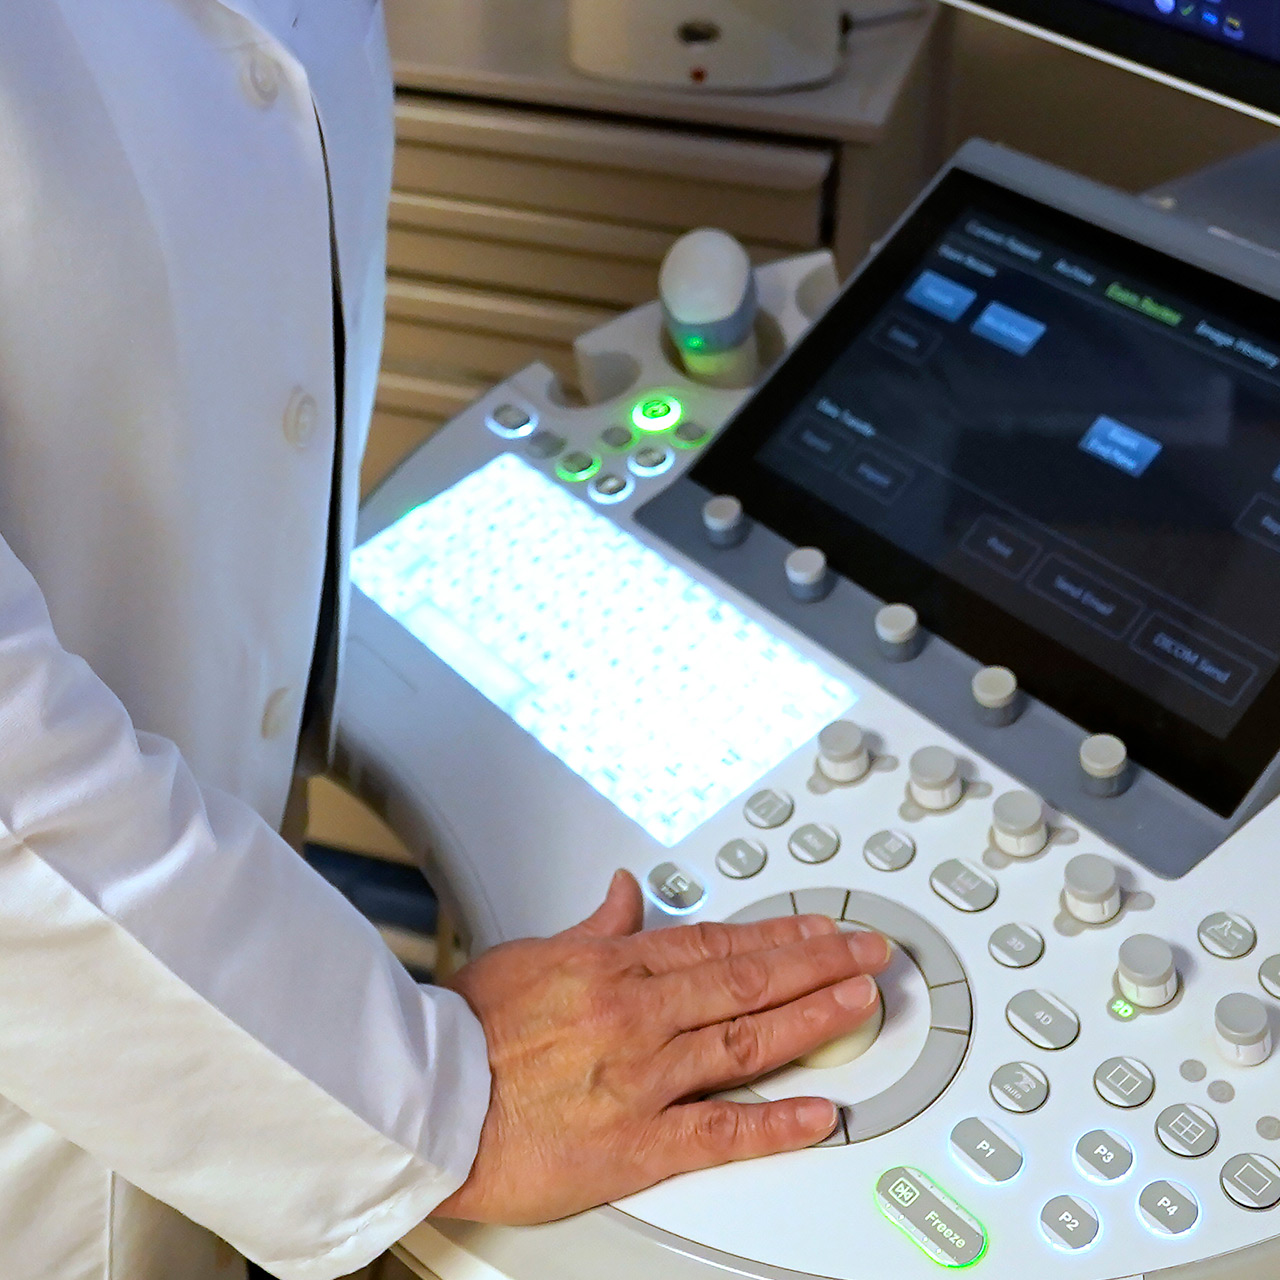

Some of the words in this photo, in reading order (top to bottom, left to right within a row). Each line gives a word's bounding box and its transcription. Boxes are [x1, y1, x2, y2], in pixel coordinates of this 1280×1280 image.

[1112, 1000, 1133, 1017] 2D
[1034, 1011, 1052, 1025] 4D
[976, 1140, 995, 1158] P1
[1094, 1145, 1114, 1163] P3
[1157, 1197, 1178, 1216] P4
[924, 1211, 966, 1249] Freeze
[1058, 1212, 1079, 1231] P2
